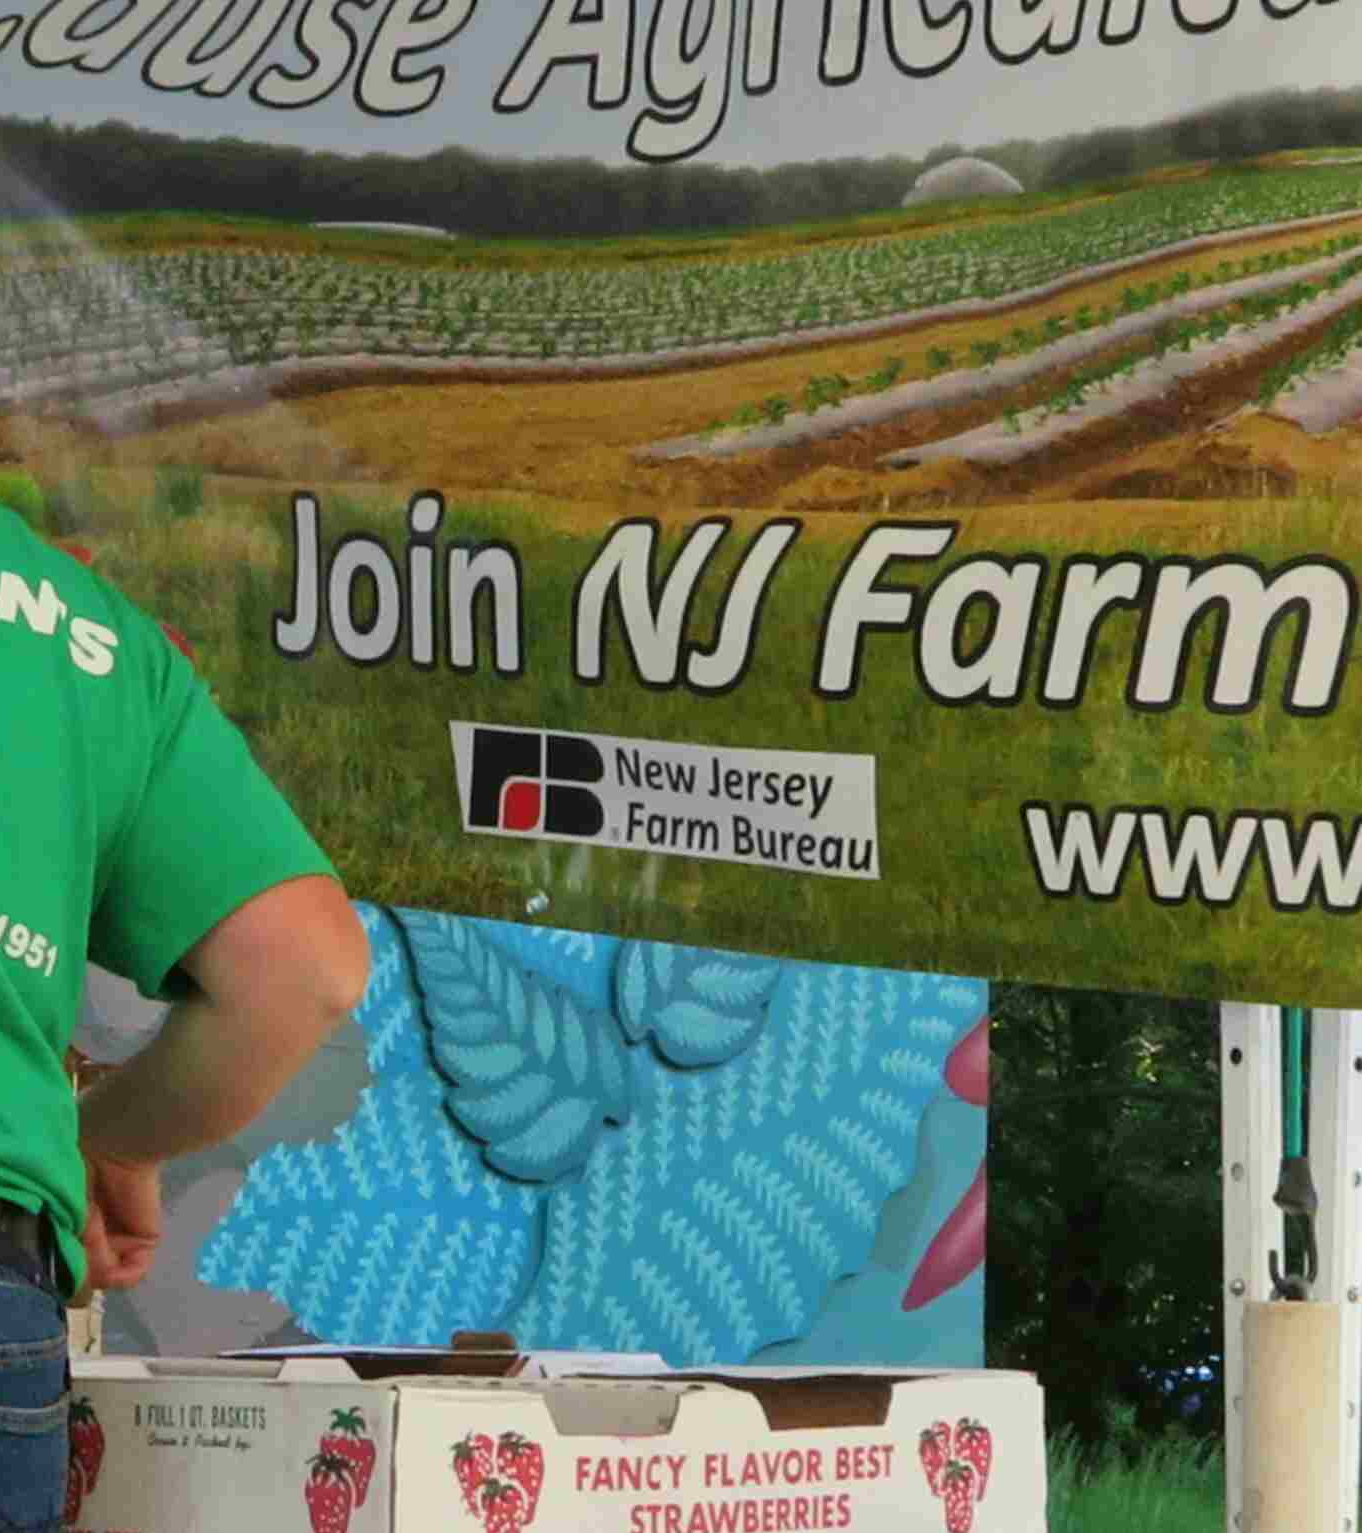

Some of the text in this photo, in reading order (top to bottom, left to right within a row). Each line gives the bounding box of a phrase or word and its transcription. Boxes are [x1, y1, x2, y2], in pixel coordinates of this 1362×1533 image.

[275, 489, 1358, 717] Join NJ Farm
[615, 747, 834, 818] New Jersey
[625, 801, 874, 872] Farm Bureau
[211, 1404, 266, 1431] BASKETS
[575, 1444, 895, 1492] FANCY FLAVOR BEST
